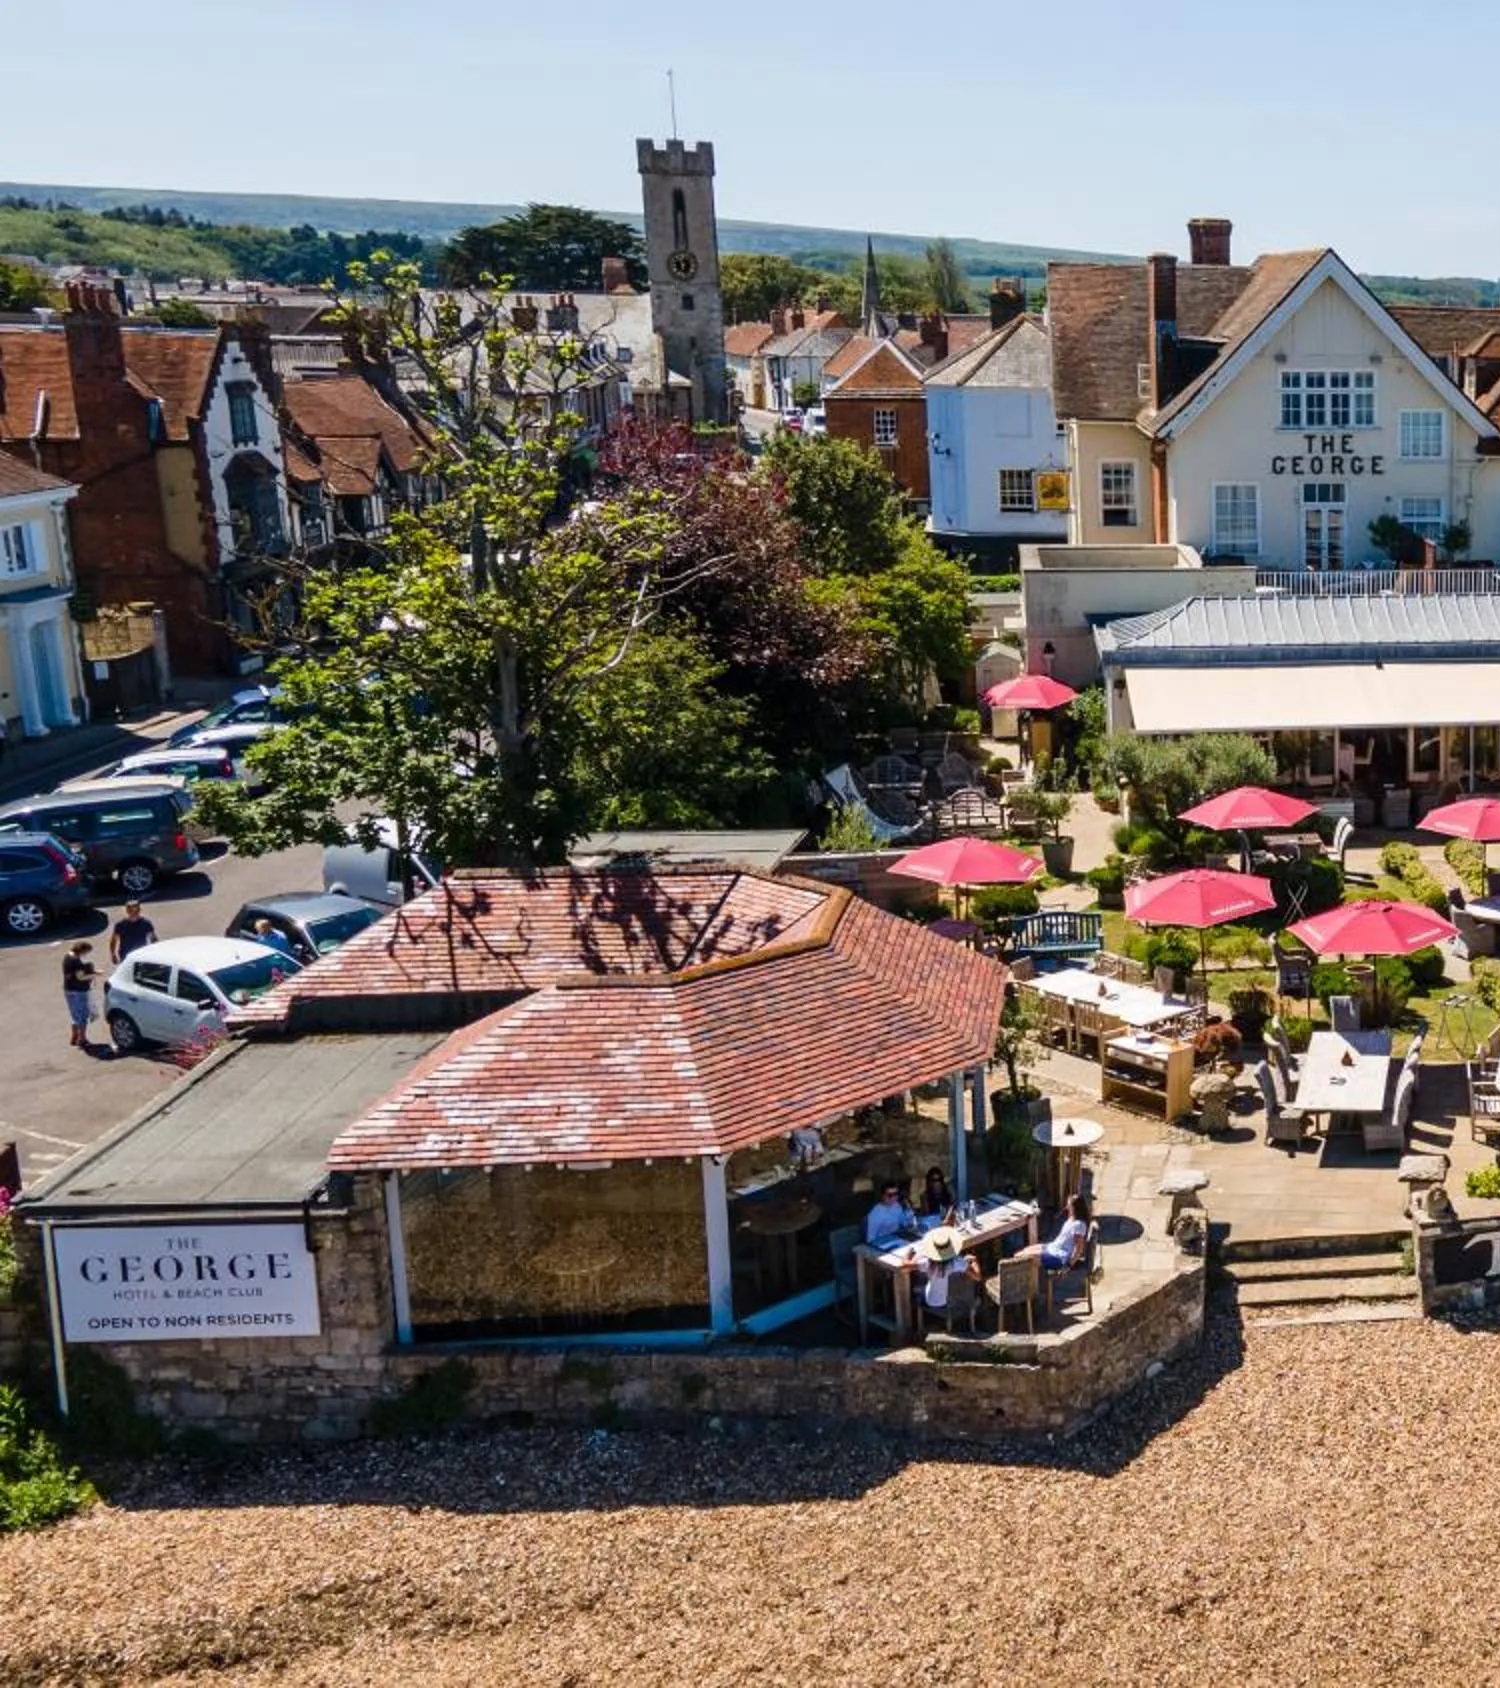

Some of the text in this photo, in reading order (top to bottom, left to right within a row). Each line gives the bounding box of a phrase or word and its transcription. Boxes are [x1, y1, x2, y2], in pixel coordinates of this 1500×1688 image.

[1303, 435, 1354, 453] THE
[1272, 456, 1384, 474] GEORGE
[165, 1237, 201, 1249] THE
[80, 1252, 292, 1283] GEORGE
[113, 1286, 263, 1301] HOTEL & BEACH CLUB
[88, 1313, 295, 1329] OPEN TO NON RESIDENTS
